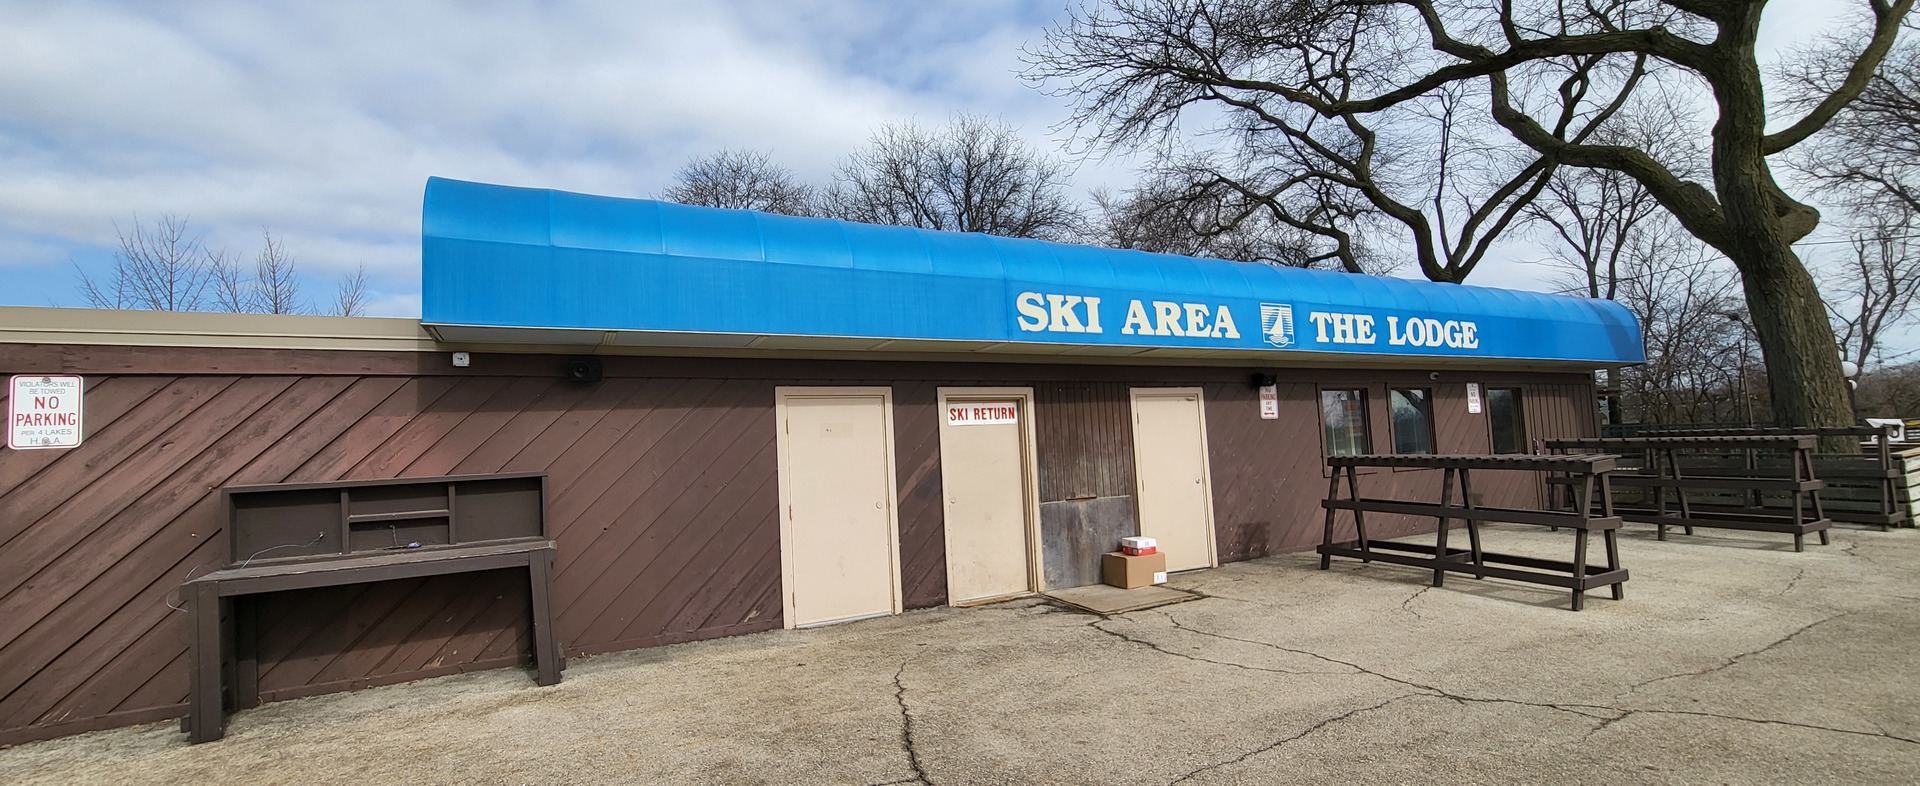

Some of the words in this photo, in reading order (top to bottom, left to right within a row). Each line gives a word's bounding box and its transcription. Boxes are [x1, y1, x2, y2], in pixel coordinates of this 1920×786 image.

[1016, 291, 1103, 333] SKI
[1121, 299, 1241, 339] AREA
[1309, 311, 1376, 345] THE
[1386, 316, 1479, 349] LODGE
[34, 396, 59, 410] NO
[16, 412, 76, 426] PARKING
[949, 407, 969, 421] SKI
[973, 407, 1015, 421] RETURN
[45, 428, 73, 436] LAKES
